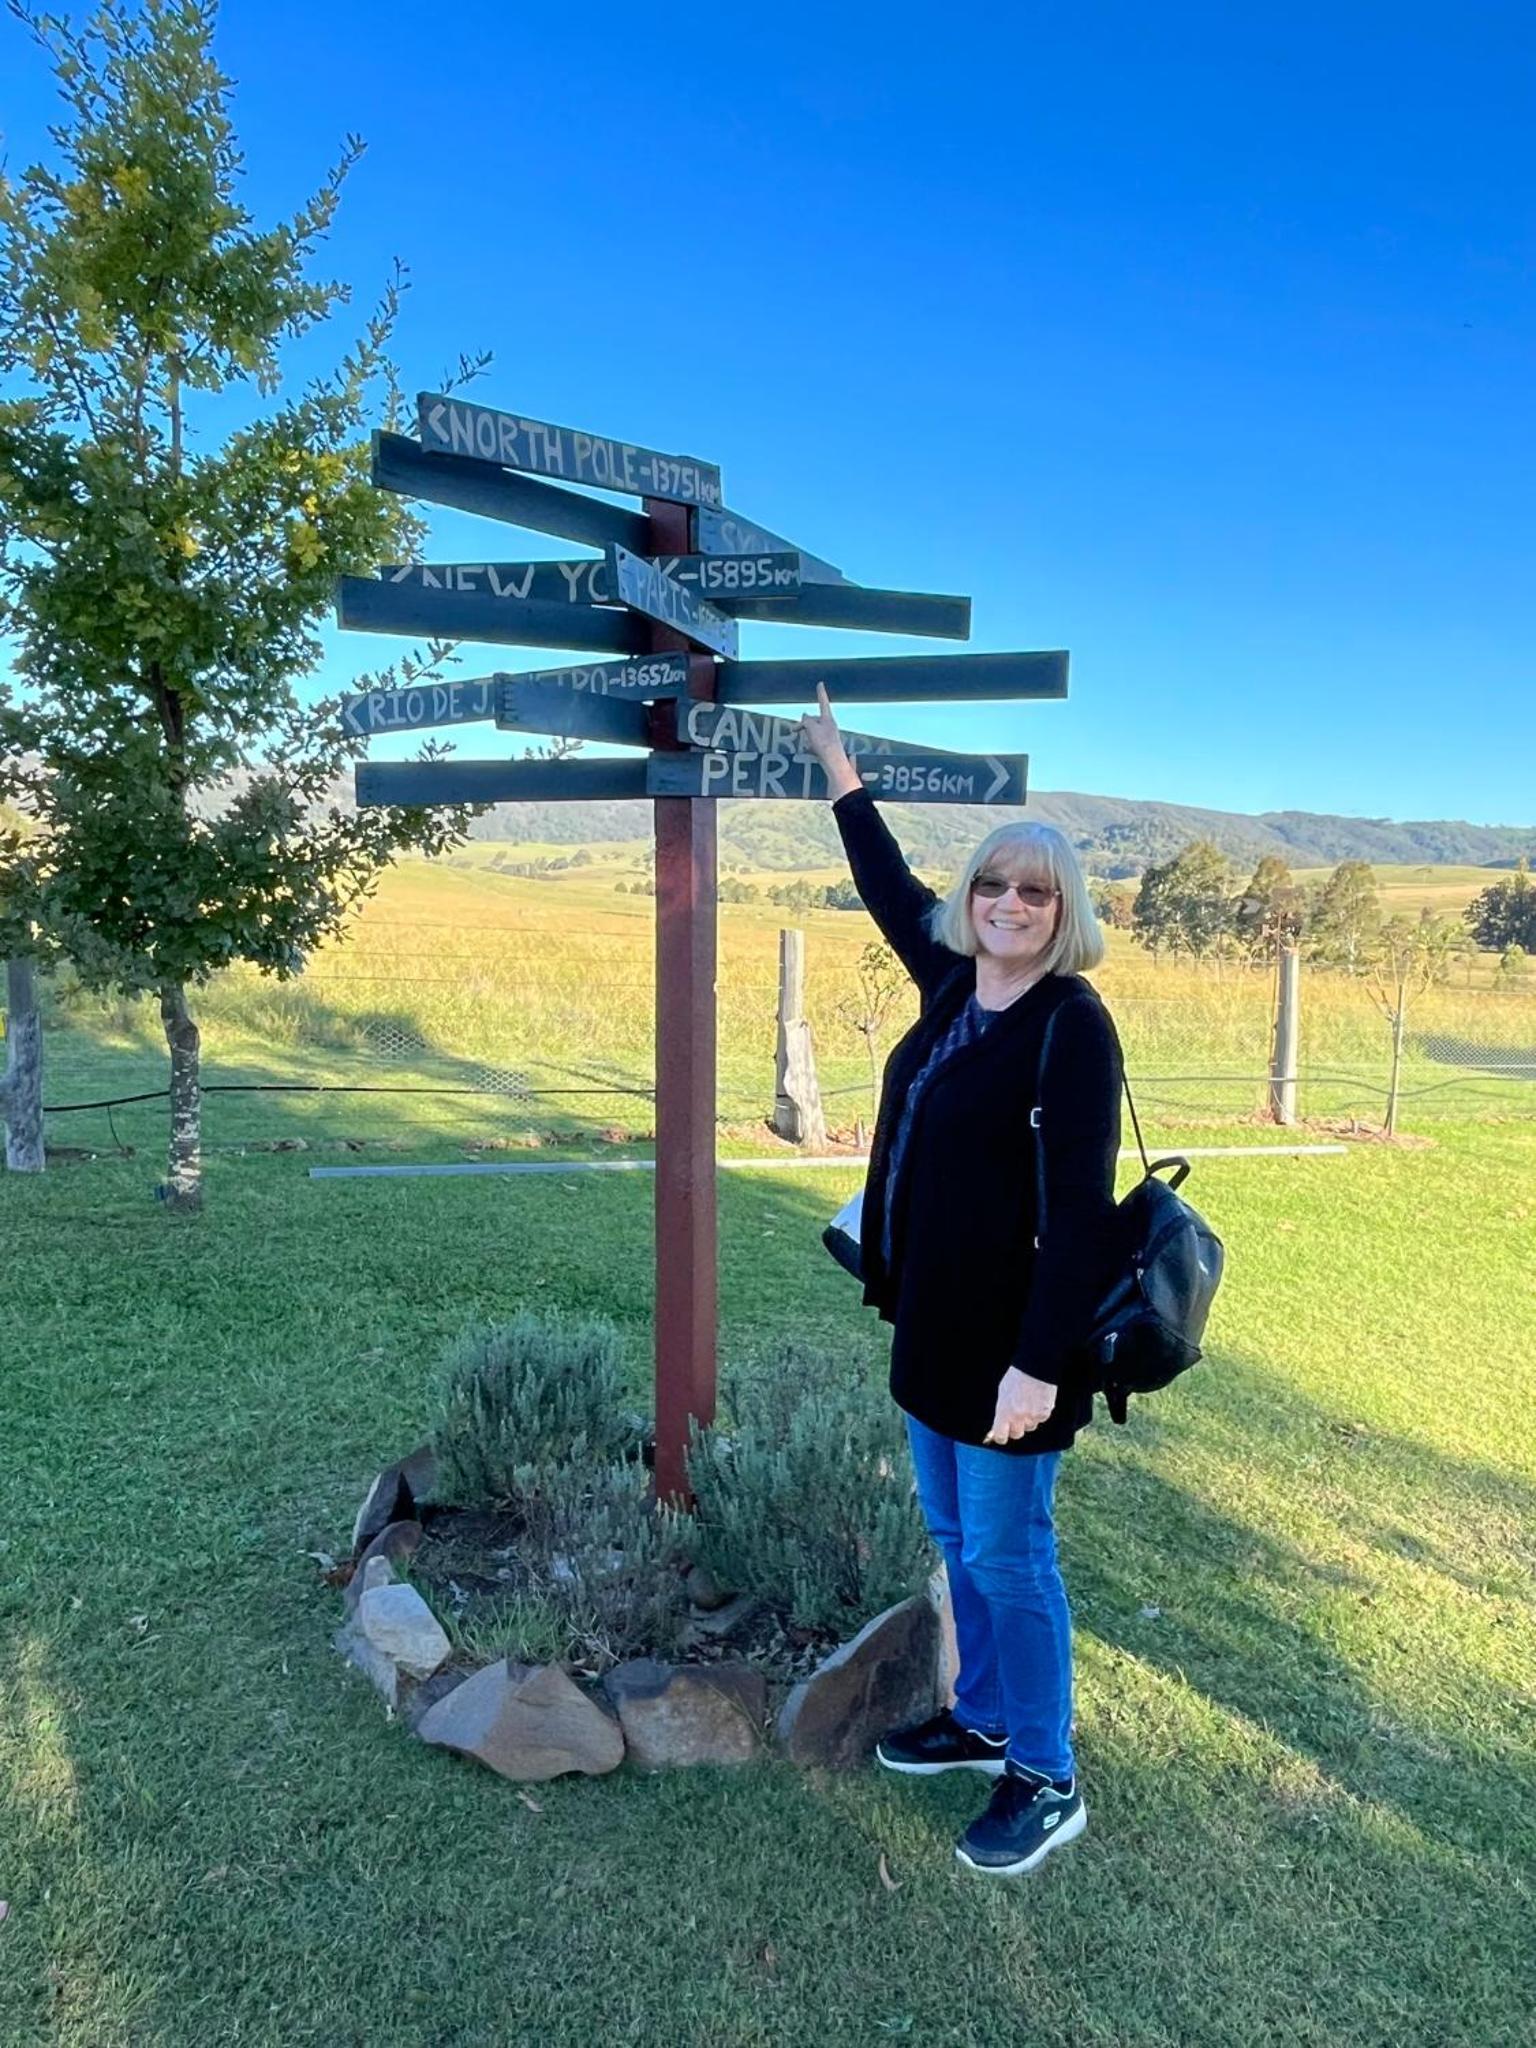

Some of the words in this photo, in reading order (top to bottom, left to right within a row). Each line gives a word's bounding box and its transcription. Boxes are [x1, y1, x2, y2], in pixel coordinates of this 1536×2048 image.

[450, 405, 563, 475] NORTH
[368, 690, 425, 727] RIO
[433, 683, 464, 721] DE
